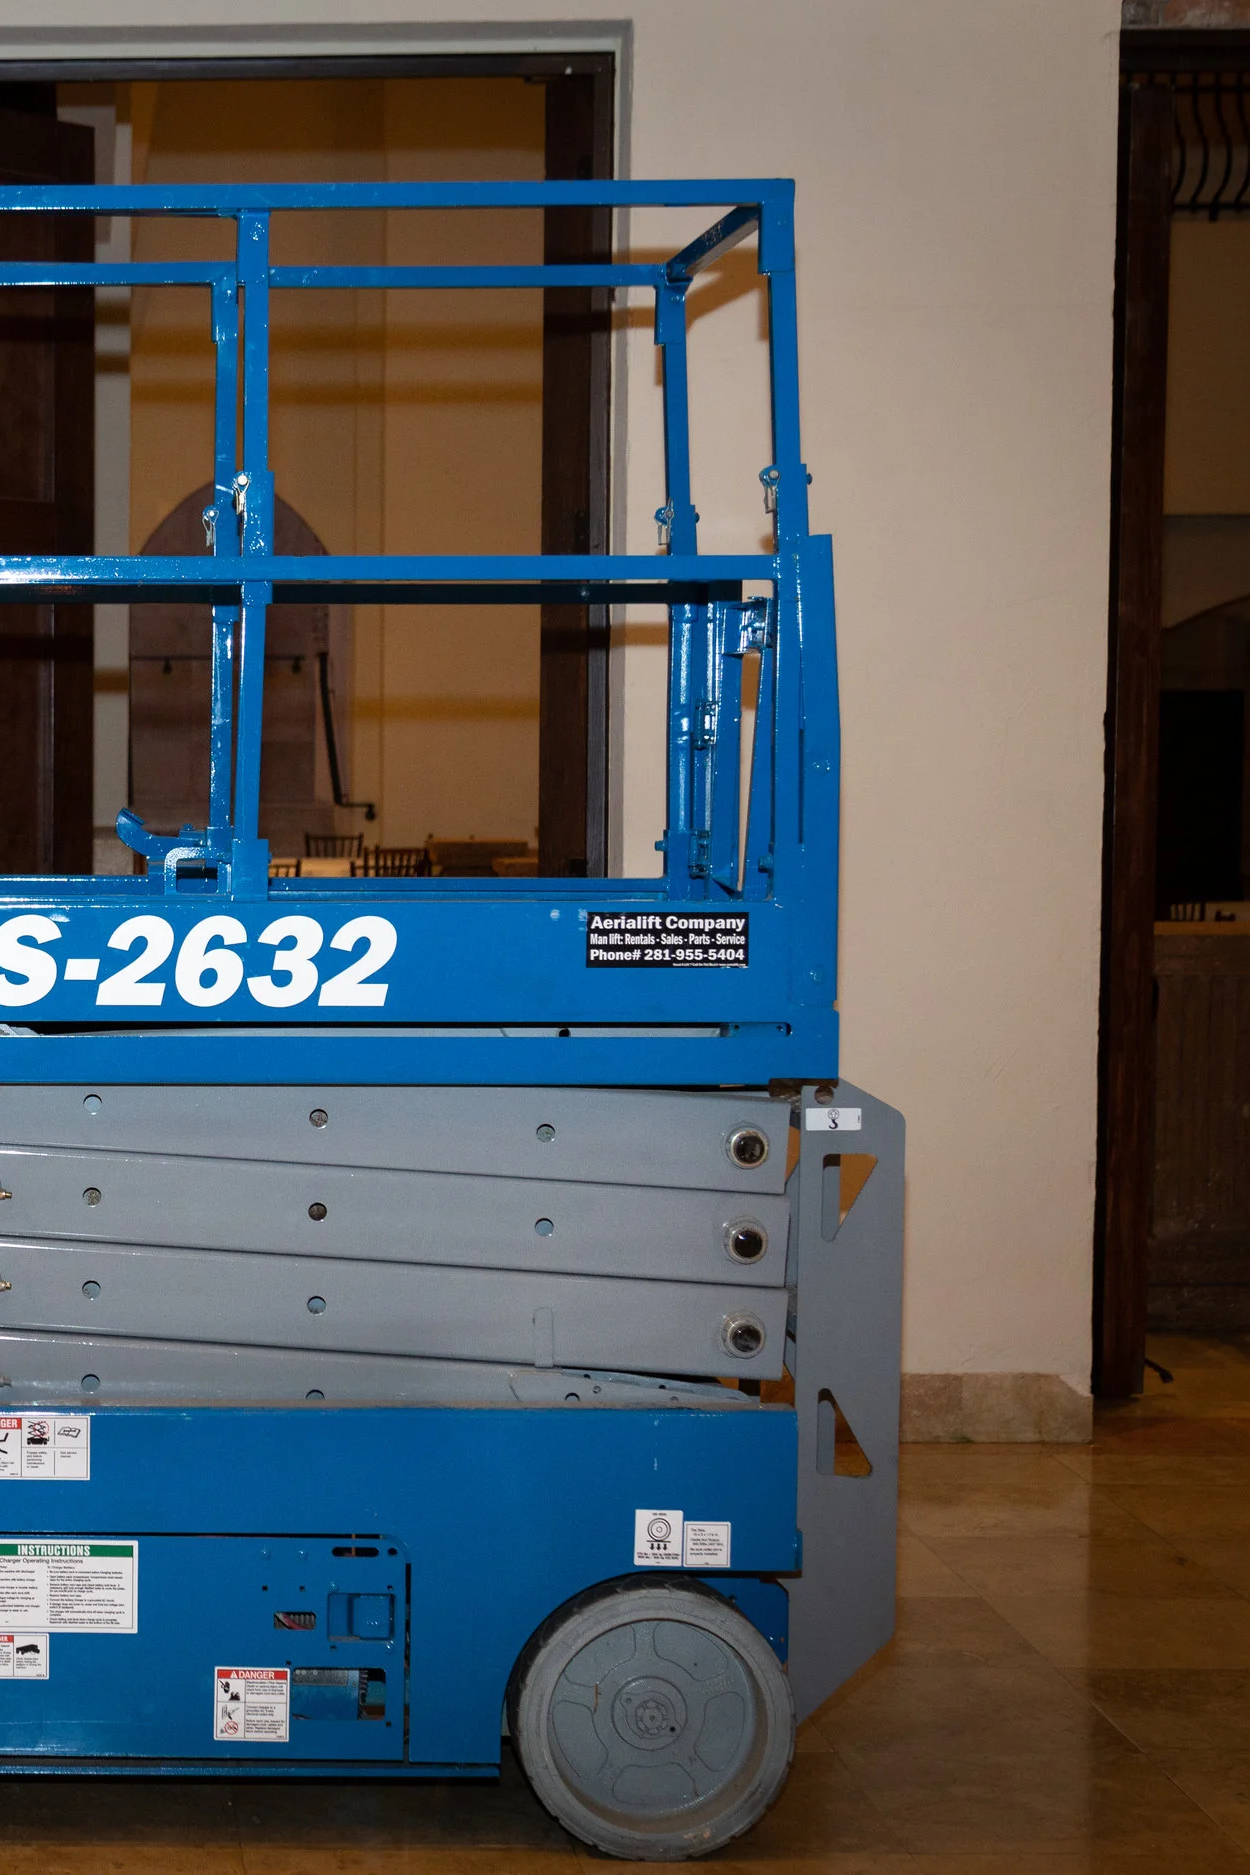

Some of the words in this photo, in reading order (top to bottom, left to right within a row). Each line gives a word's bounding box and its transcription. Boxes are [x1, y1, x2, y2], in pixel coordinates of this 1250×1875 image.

[590, 916, 662, 929] Aerialift
[665, 916, 746, 932] Company
[590, 933, 607, 945] Man
[609, 933, 623, 945] lift:
[625, 933, 655, 945] Rentals
[660, 933, 683, 945] Sales
[689, 933, 710, 945] Parts
[716, 933, 745, 945] Service
[590, 949, 641, 961] Phone#
[644, 949, 744, 961] 281-955-5404
[17, 1544, 91, 1556] INSTRUCTIONS
[238, 1671, 275, 1679] DANGER
